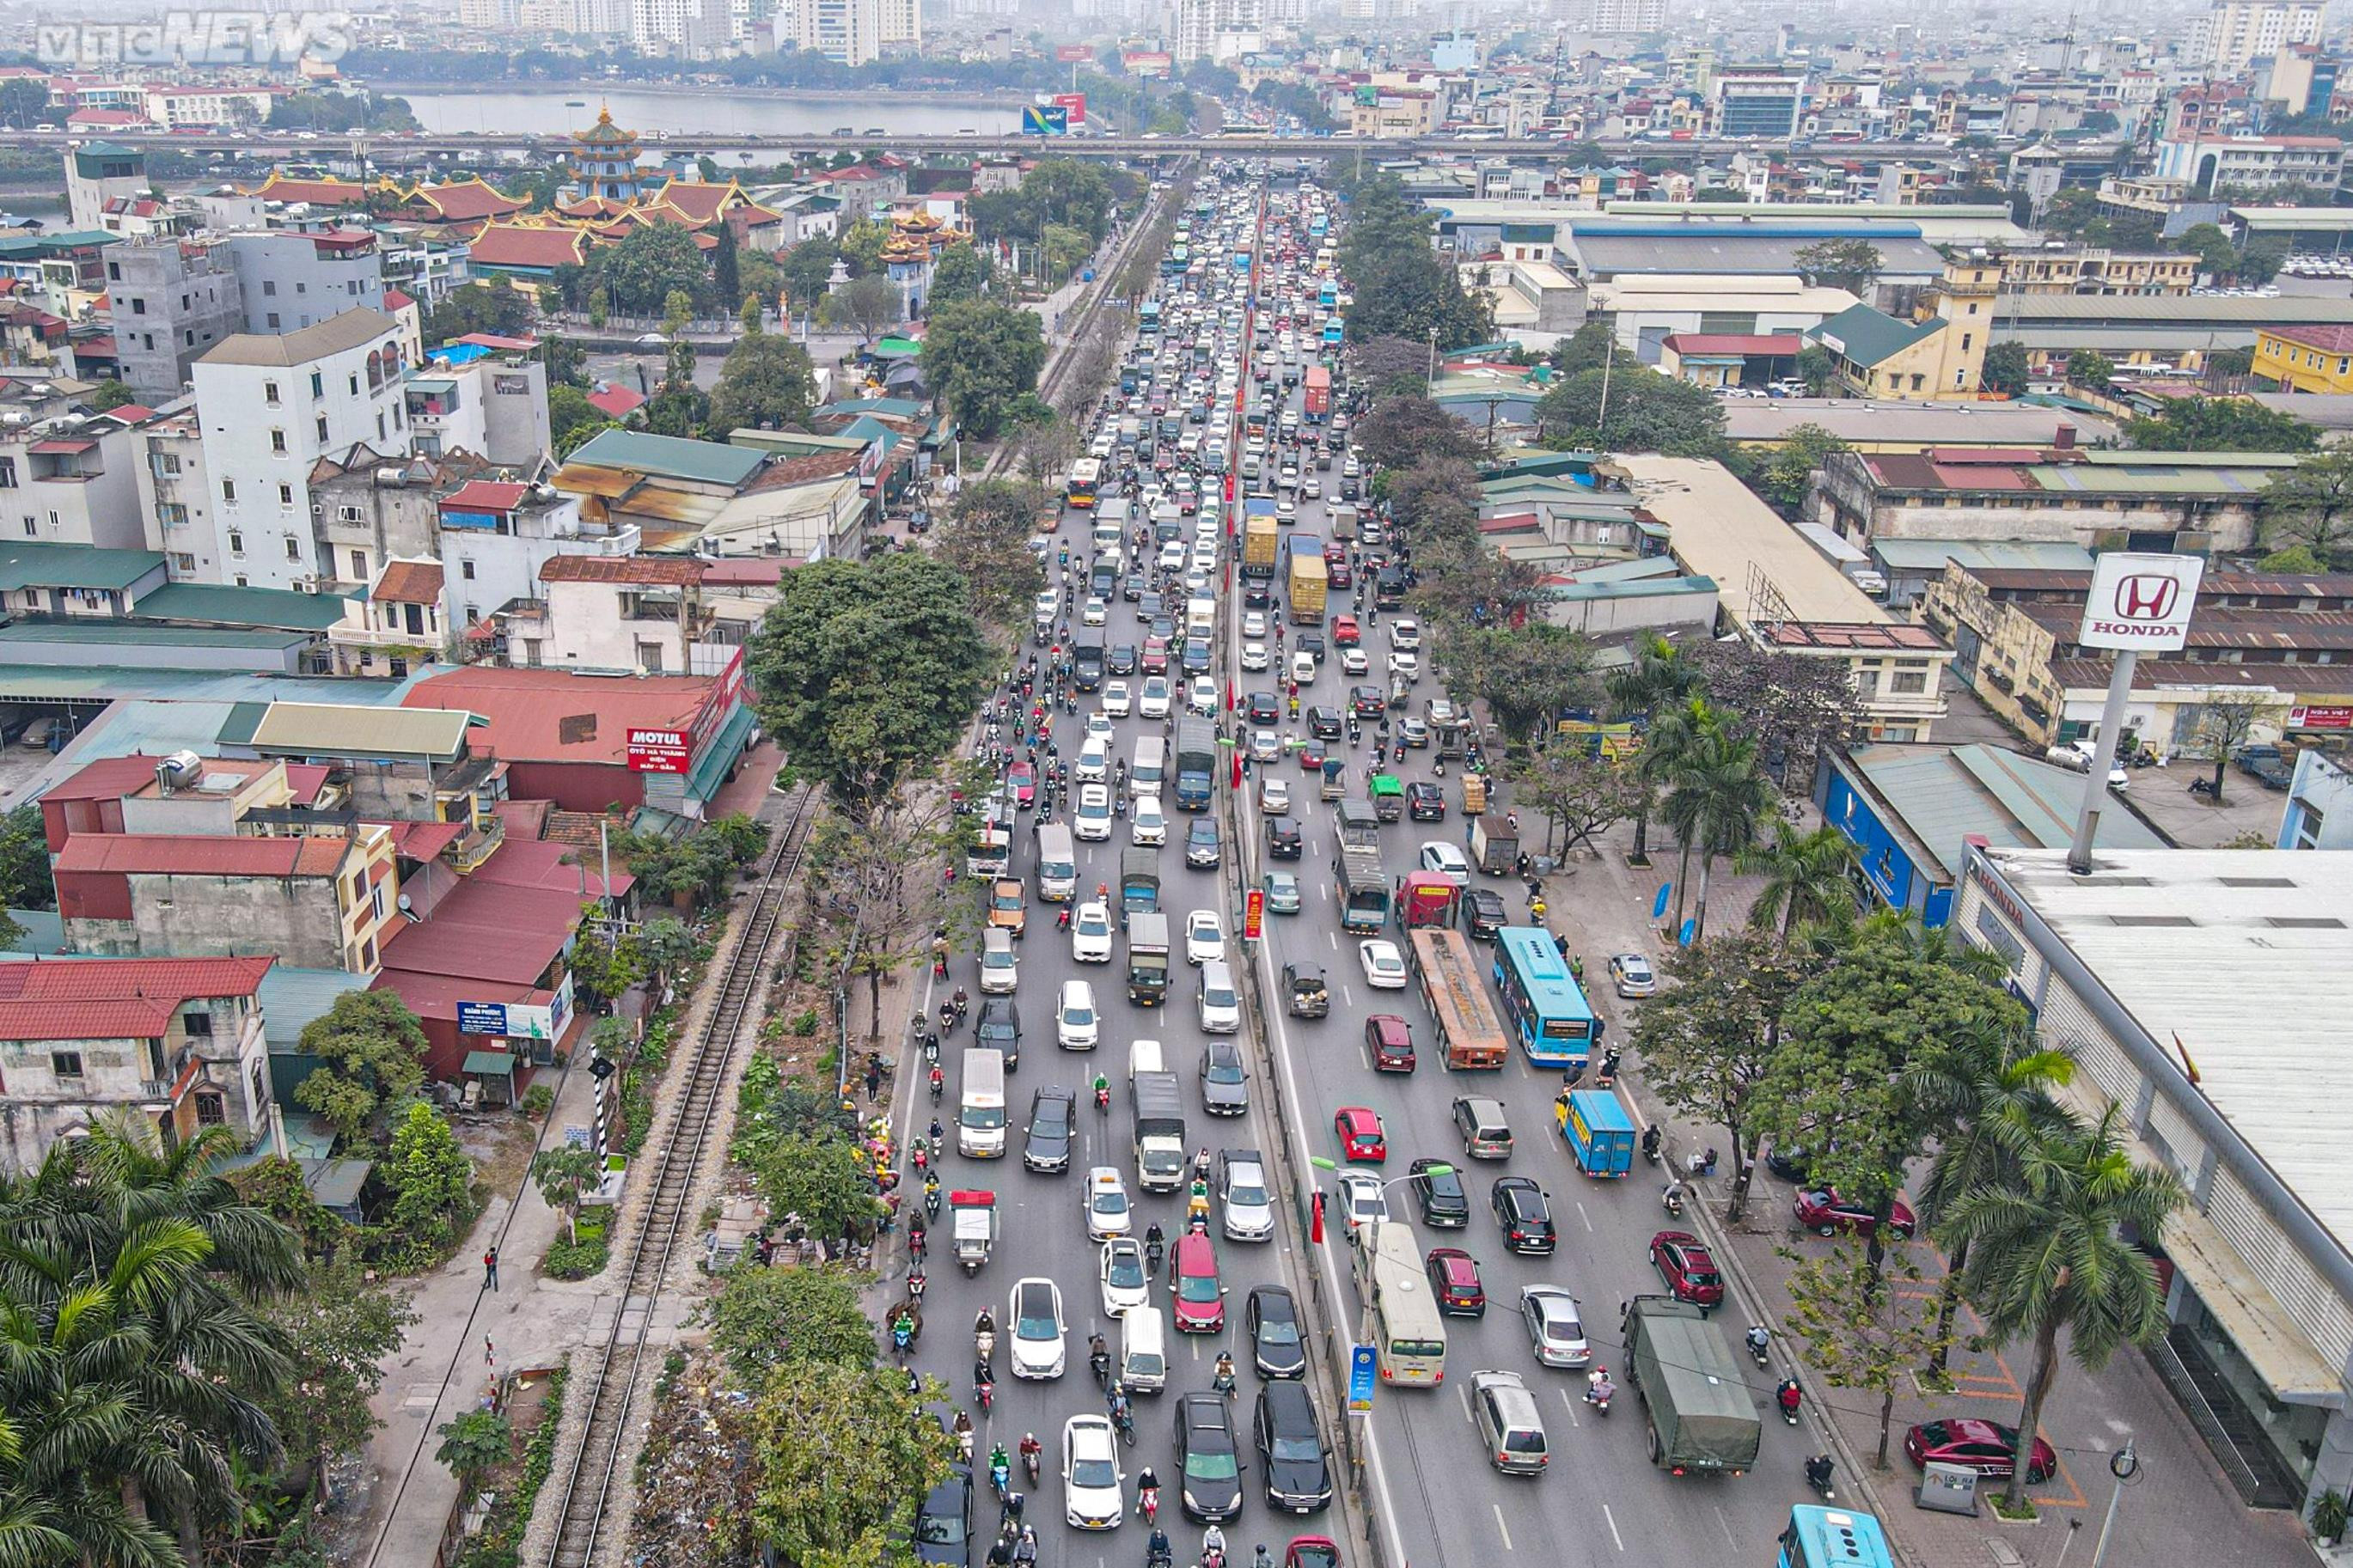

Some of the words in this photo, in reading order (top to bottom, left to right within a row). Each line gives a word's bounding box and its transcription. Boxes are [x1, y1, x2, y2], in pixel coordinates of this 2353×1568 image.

[2092, 621, 2180, 637] HONDA
[632, 731, 682, 746] MOTUL
[1979, 870, 2024, 929] HONDA
